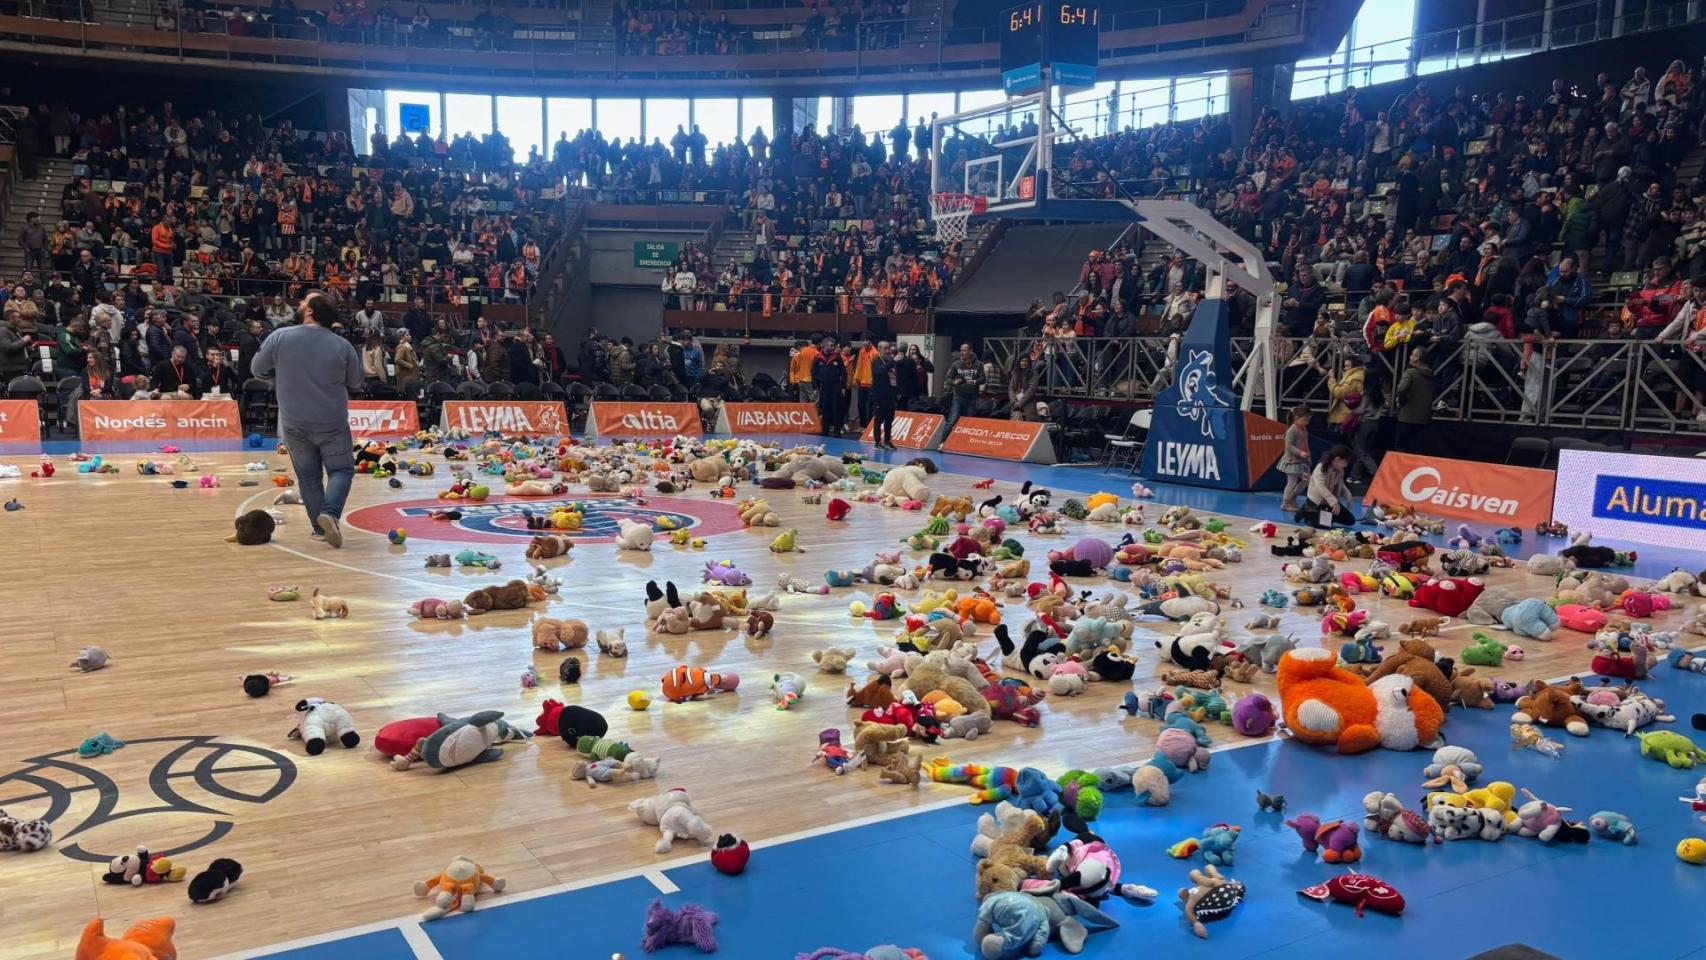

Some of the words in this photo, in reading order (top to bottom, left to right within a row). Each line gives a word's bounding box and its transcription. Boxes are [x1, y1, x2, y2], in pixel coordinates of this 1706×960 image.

[1010, 4, 1041, 31] 6:41
[1060, 5, 1097, 26] 6:41
[646, 243, 665, 251] SALIDA
[94, 412, 167, 429] Nordés
[457, 405, 535, 432] LEYMA
[1156, 440, 1222, 481] LEYMA
